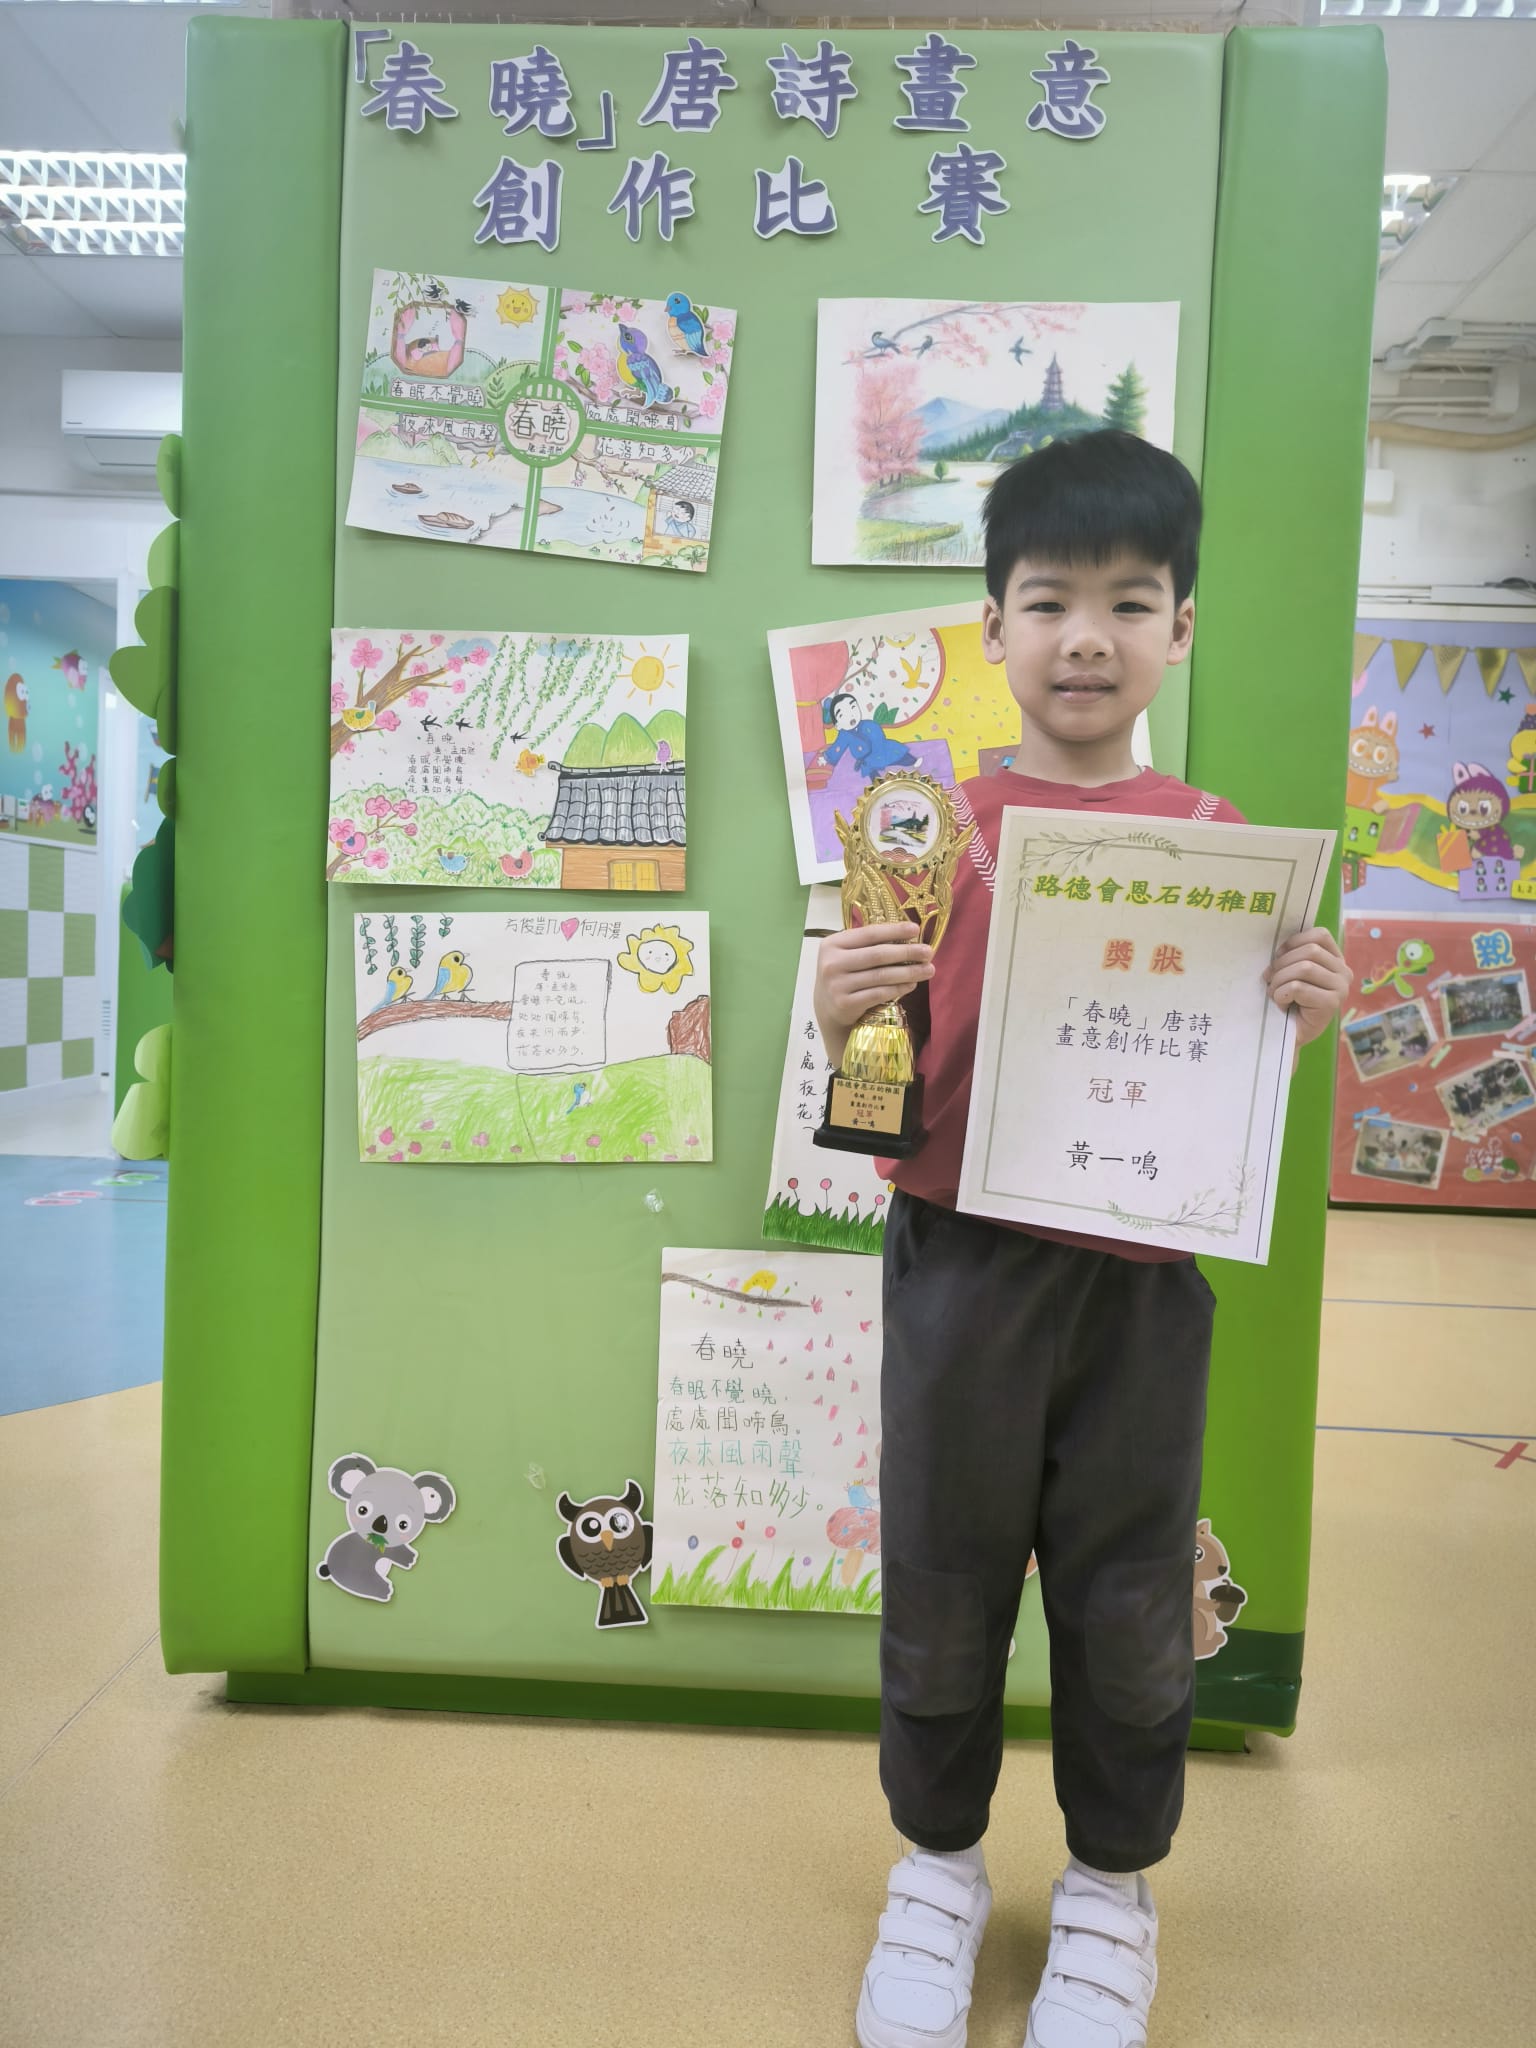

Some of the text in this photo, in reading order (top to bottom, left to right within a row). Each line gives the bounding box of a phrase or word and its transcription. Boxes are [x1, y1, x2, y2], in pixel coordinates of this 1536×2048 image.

[473, 143, 1008, 250] 創作比賽
[513, 401, 566, 441] 春曉
[1033, 875, 1276, 916] 路德會恩石幼稚園
[1103, 940, 1185, 975] 獎狀
[1474, 931, 1514, 968] 親
[1067, 996, 1213, 1034] 「春曉」唐詩
[1055, 1023, 1208, 1062] 畫意創作比賽
[1087, 1077, 1147, 1108] 冠軍
[1065, 1141, 1158, 1181] 黃一鳴
[691, 1332, 753, 1369] 春曉
